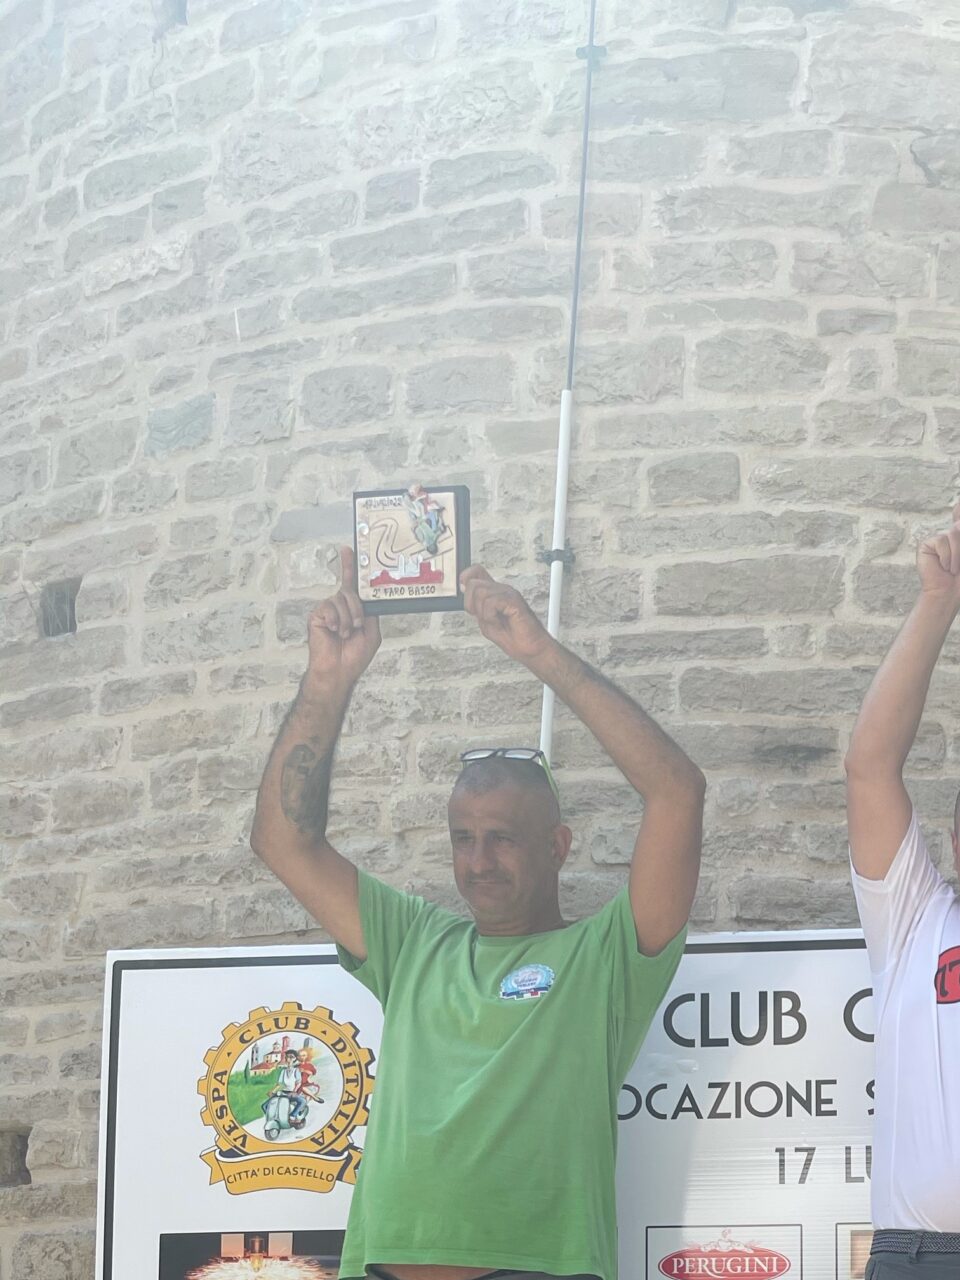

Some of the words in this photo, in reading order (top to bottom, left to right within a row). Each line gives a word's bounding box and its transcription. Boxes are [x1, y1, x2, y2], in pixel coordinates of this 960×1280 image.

[384, 586, 404, 597] FARO
[408, 586, 436, 595] BASSO
[662, 990, 807, 1048] CLUB
[212, 1069, 248, 1149] VESPA
[239, 1017, 311, 1045] CLUB
[310, 1037, 360, 1147] D'ITALIA
[226, 1168, 260, 1184] CITTA'
[263, 1166, 274, 1176] DI
[277, 1166, 335, 1183] CASTELLO
[775, 1147, 816, 1184] 17
[671, 1257, 779, 1279] PERUGINI
